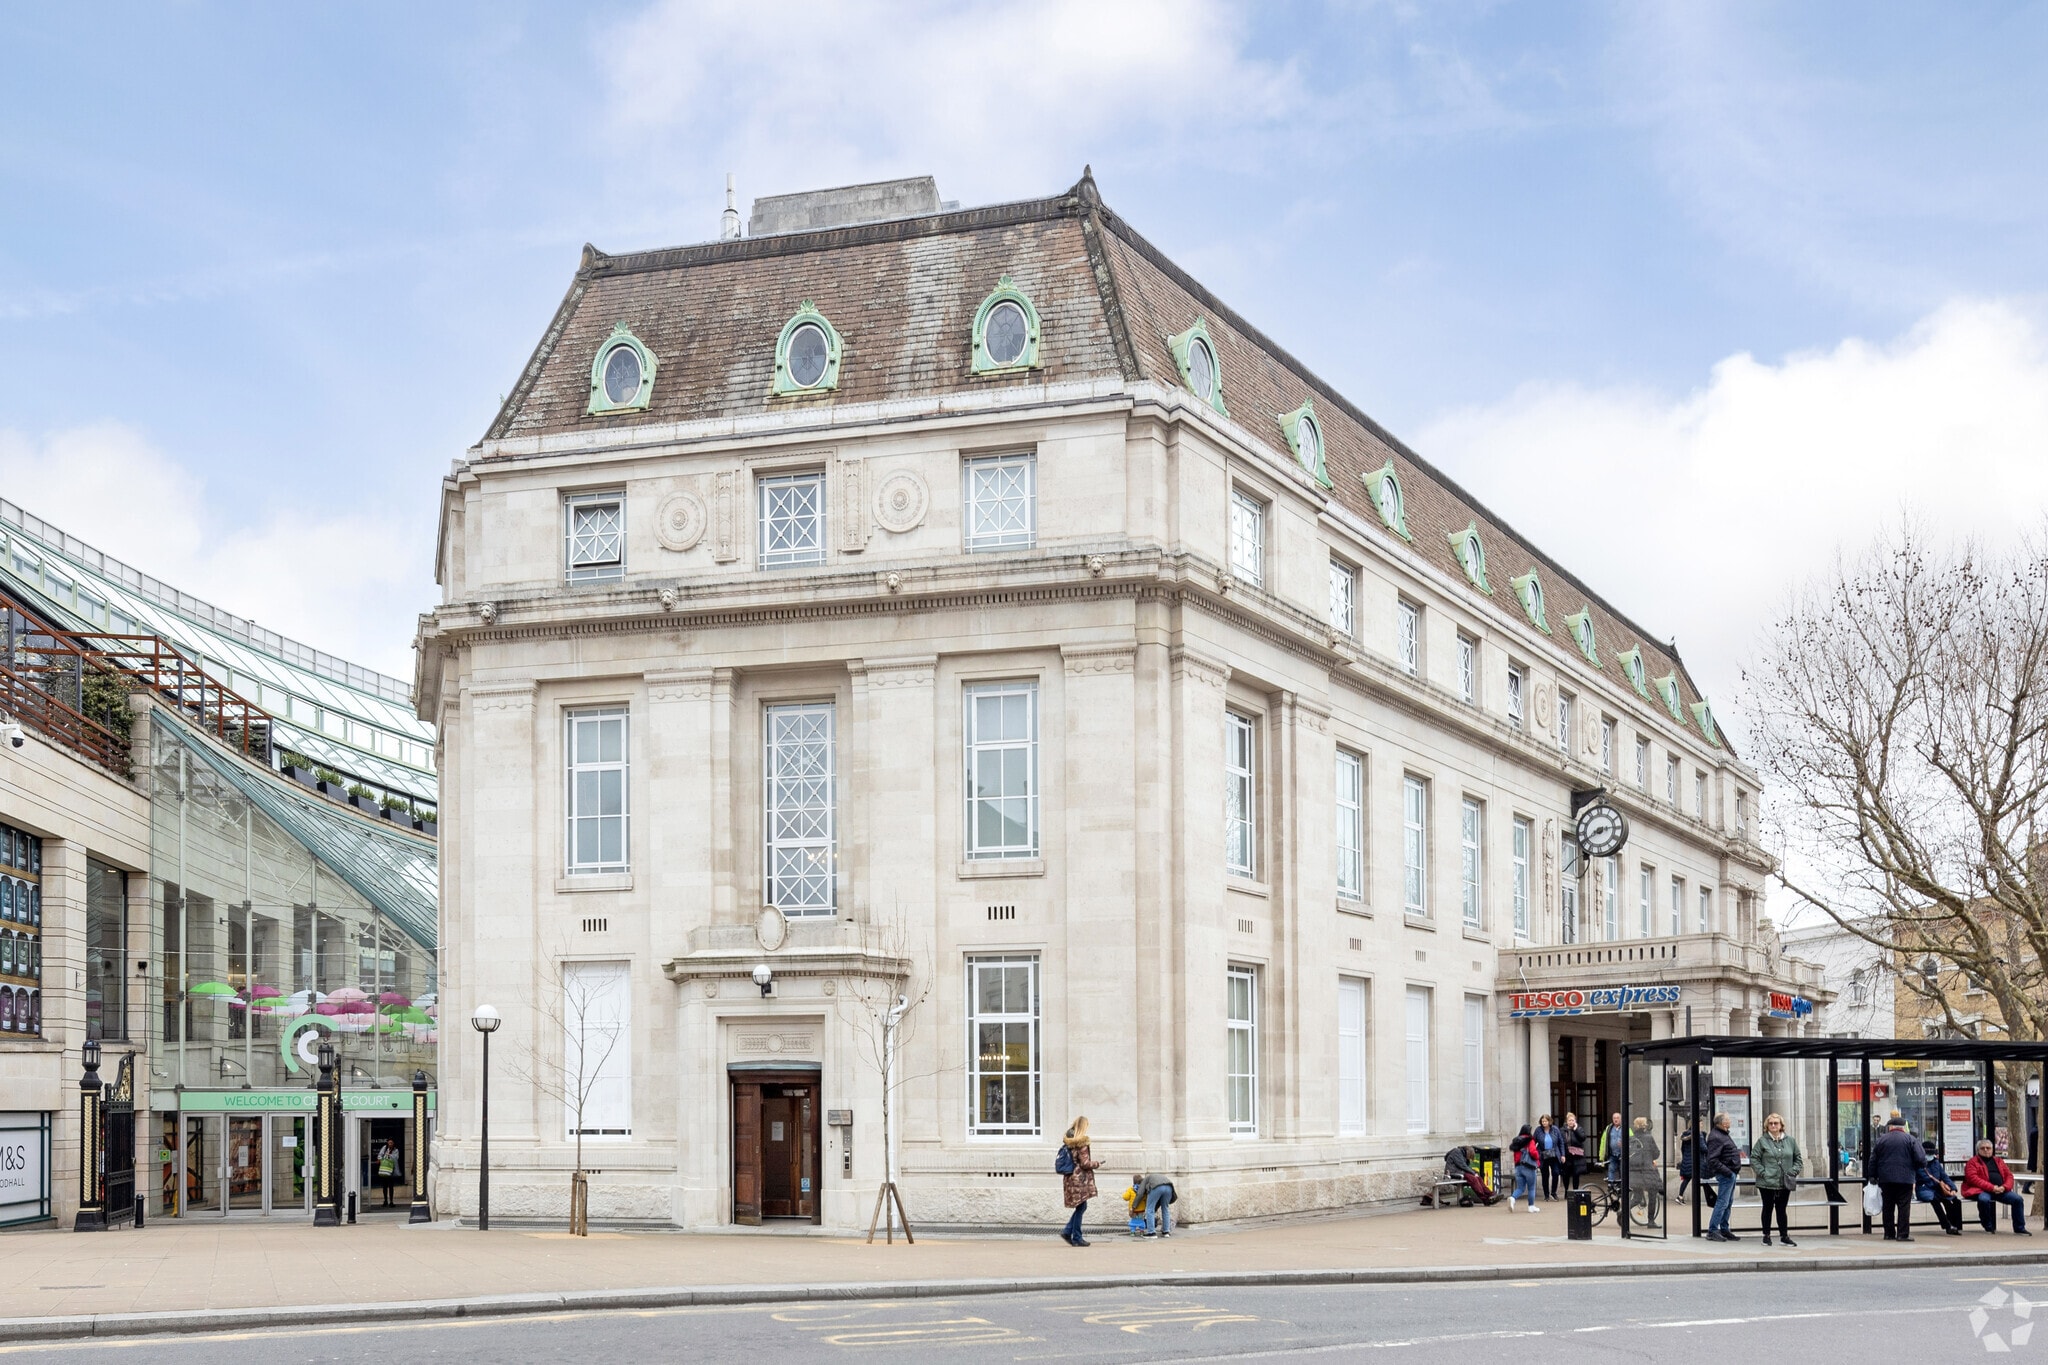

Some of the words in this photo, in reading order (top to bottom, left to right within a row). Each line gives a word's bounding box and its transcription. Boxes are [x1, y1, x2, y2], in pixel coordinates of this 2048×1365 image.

[1508, 990, 1584, 1010] TESCO
[1590, 984, 1682, 1011] express
[224, 1095, 284, 1107] WELCOME
[285, 1095, 302, 1107] TO
[303, 1095, 351, 1107] CEE
[350, 1095, 390, 1107] COURT
